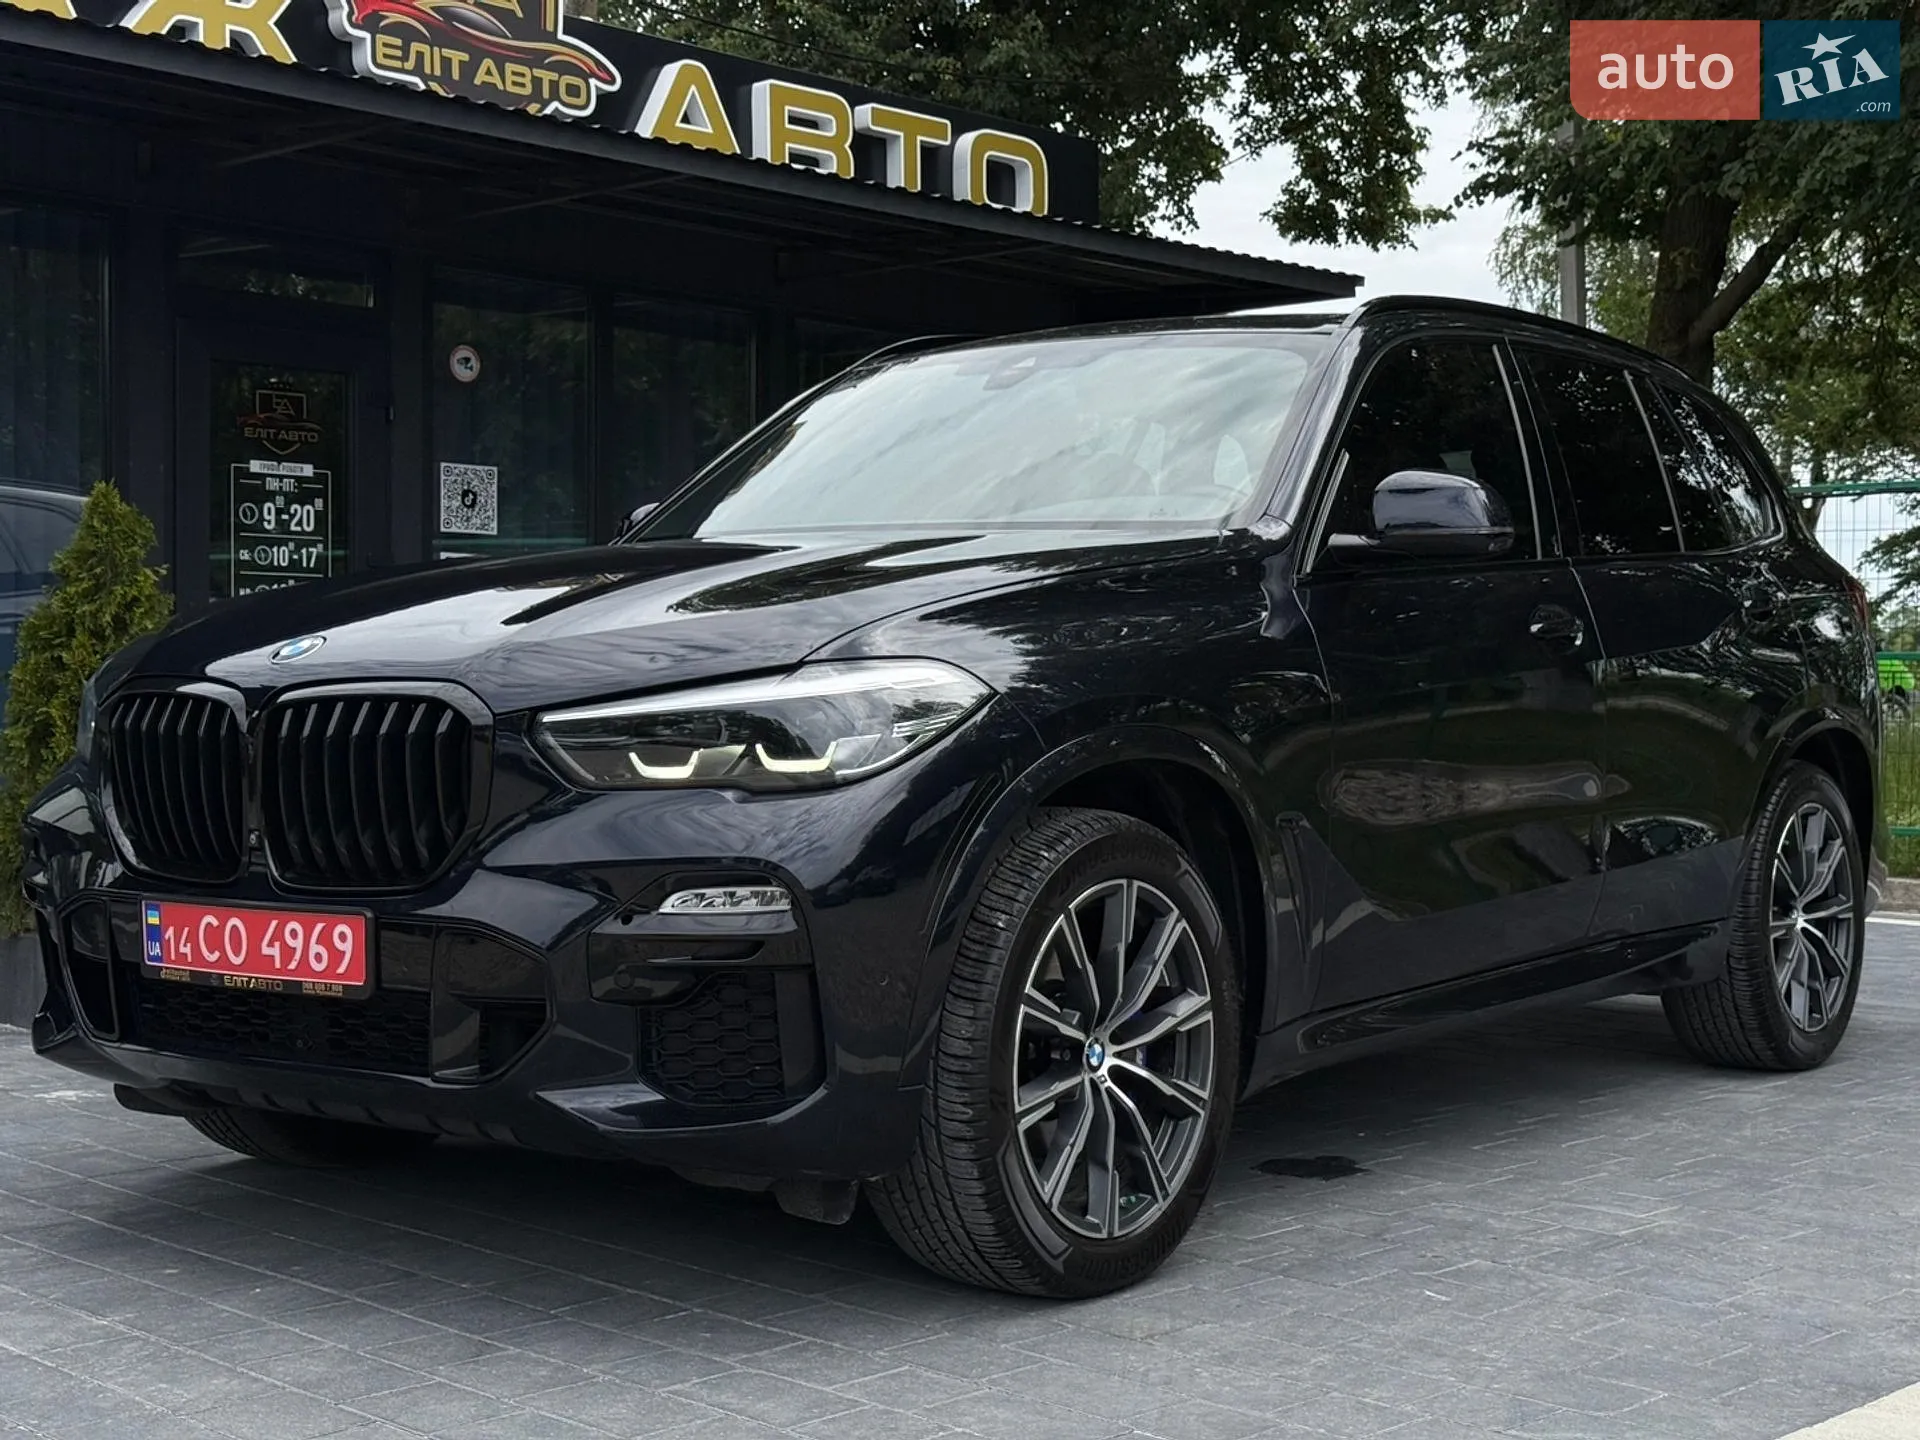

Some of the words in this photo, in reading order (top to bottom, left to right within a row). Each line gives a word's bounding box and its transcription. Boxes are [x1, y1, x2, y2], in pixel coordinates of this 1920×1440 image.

[375, 34, 470, 81] ЕЛІТ
[473, 58, 588, 107] АВТО
[278, 429, 319, 443] АВТО
[265, 476, 298, 493] ПН-ПТ:
[147, 941, 162, 957] UA
[164, 925, 193, 964] 14
[198, 914, 248, 967] CO
[261, 919, 353, 975] 4969
